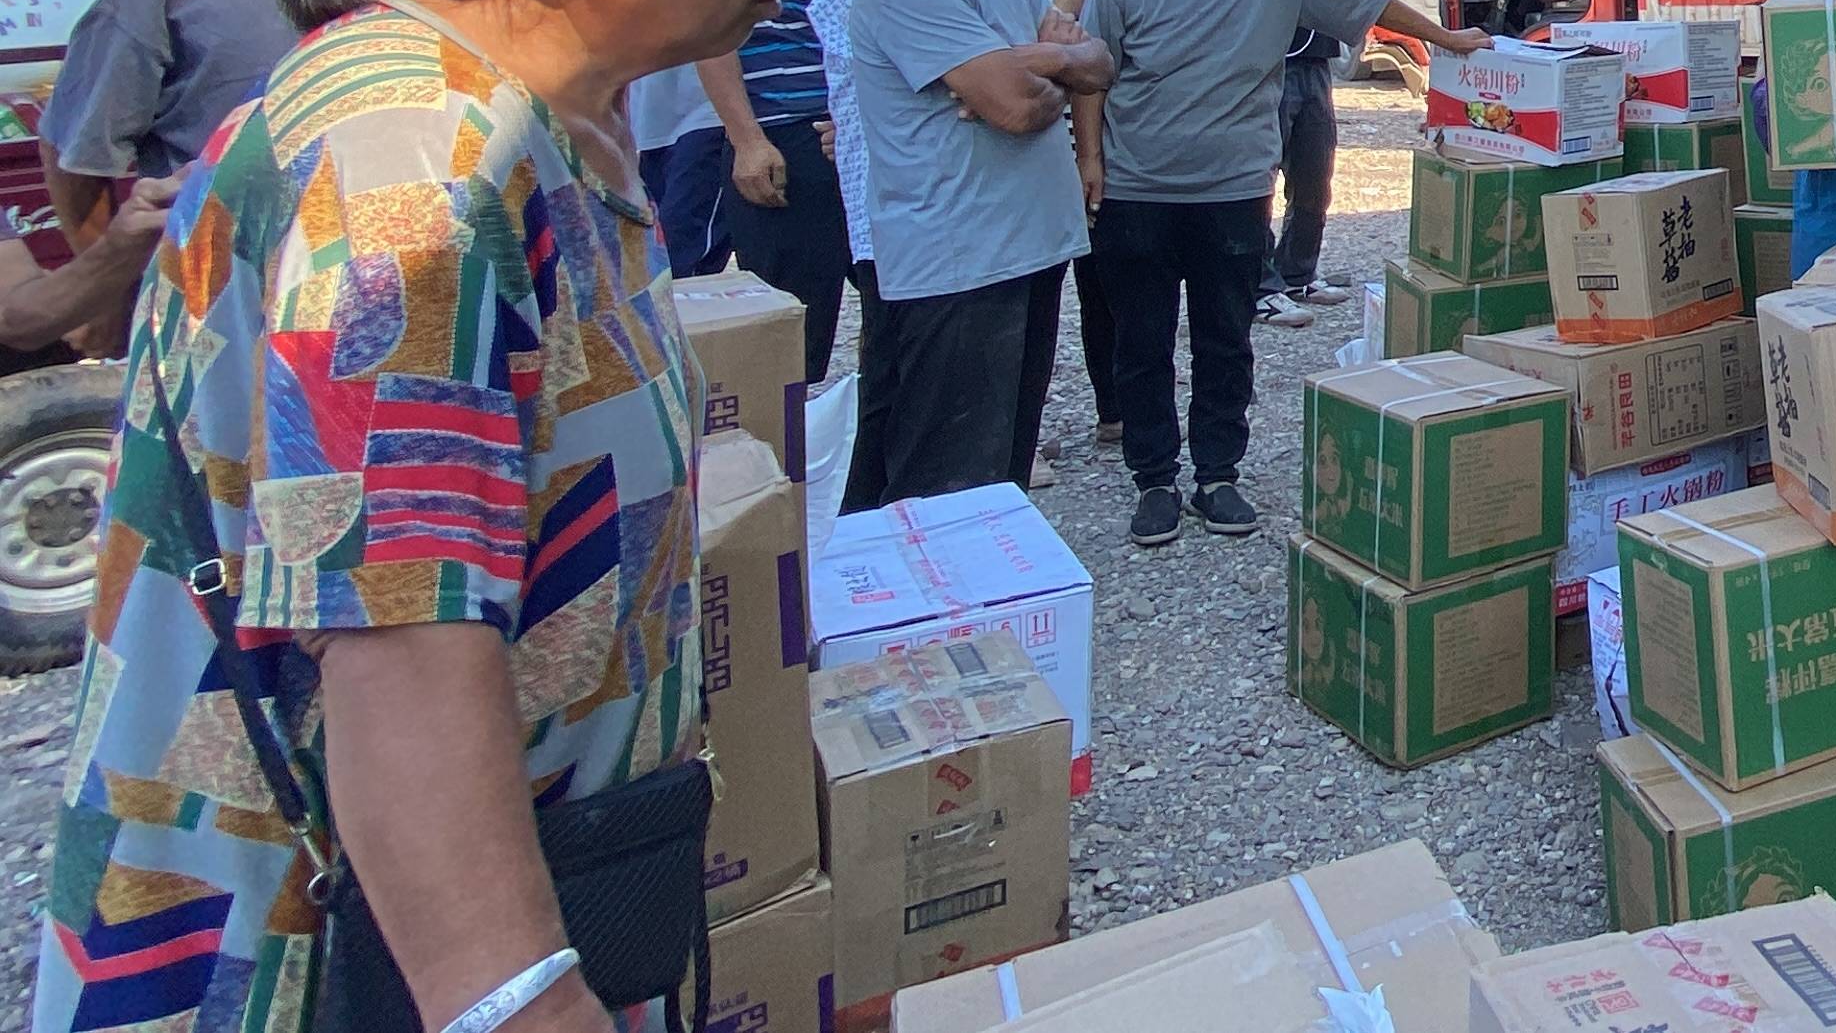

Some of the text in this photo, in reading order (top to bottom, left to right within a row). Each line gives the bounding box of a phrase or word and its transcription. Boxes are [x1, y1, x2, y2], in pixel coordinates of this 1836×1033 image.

[1458, 63, 1521, 96] 火锅川粉
[1609, 469, 1725, 524] 手工火锅粉
